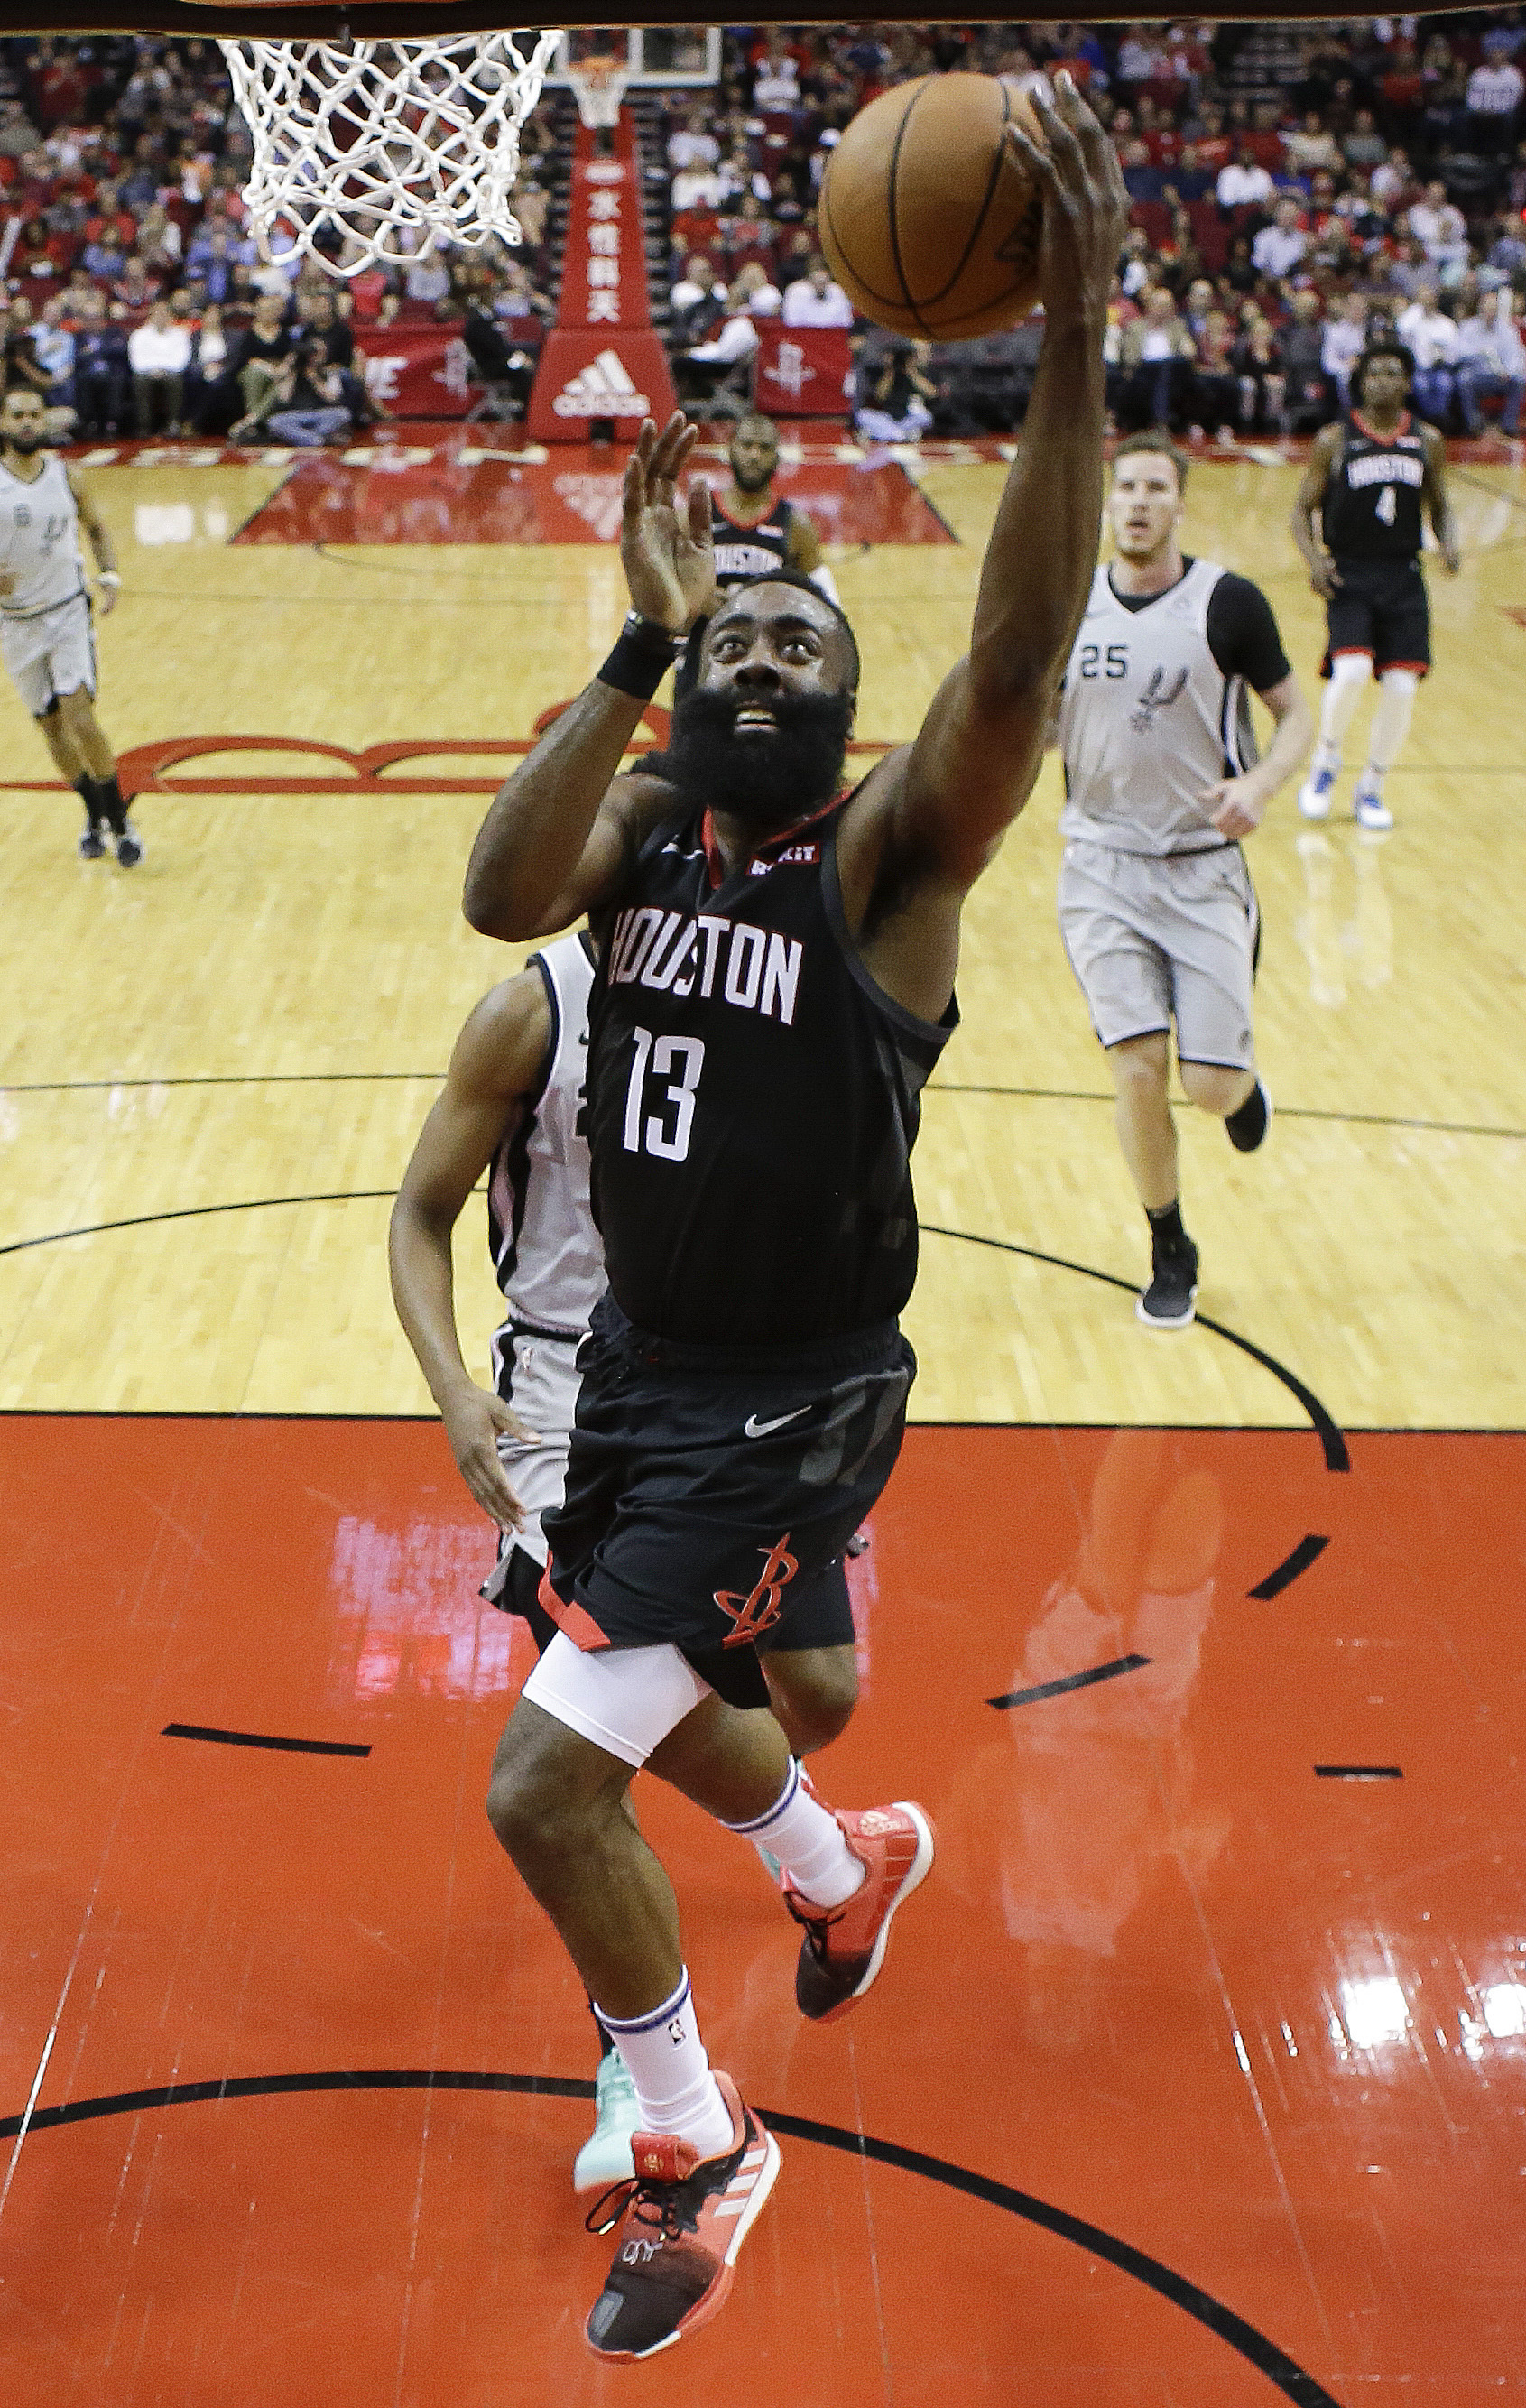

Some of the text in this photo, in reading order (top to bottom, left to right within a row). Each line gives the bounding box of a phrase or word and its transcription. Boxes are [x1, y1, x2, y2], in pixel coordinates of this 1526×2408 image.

[1375, 485, 1397, 526] 4
[1082, 644, 1128, 677] 25
[623, 1025, 705, 1162] 13
